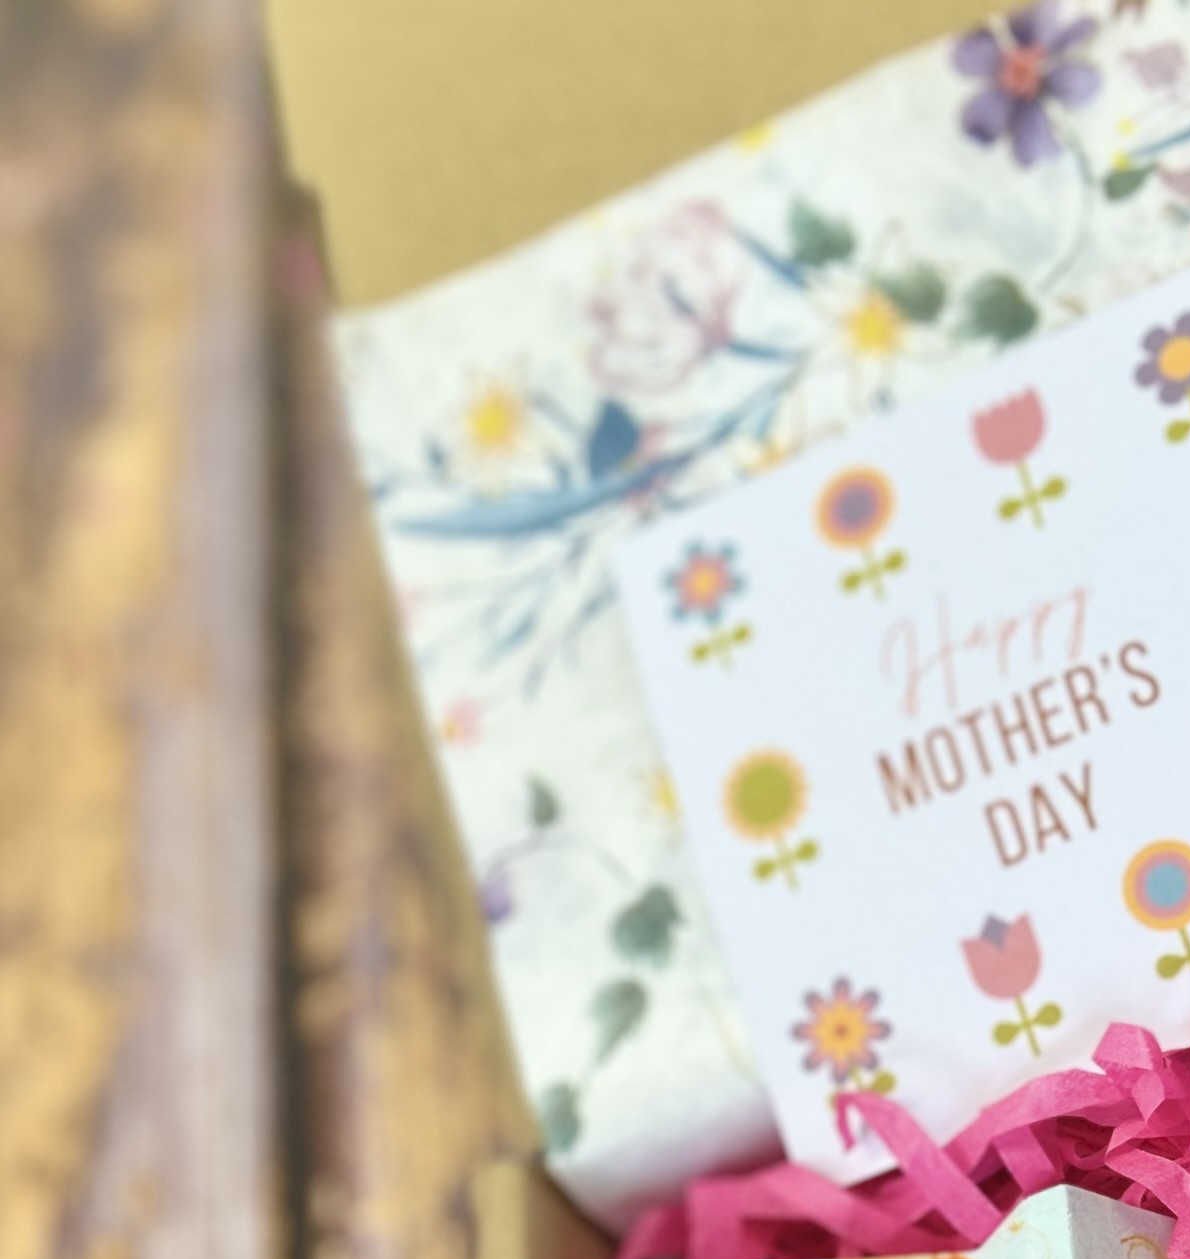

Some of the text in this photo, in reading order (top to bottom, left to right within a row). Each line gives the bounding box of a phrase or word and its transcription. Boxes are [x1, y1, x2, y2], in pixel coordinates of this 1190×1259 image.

[879, 585, 1092, 719] Happy
[875, 640, 1161, 816] MOTHER'S
[983, 761, 1097, 868] DAY
